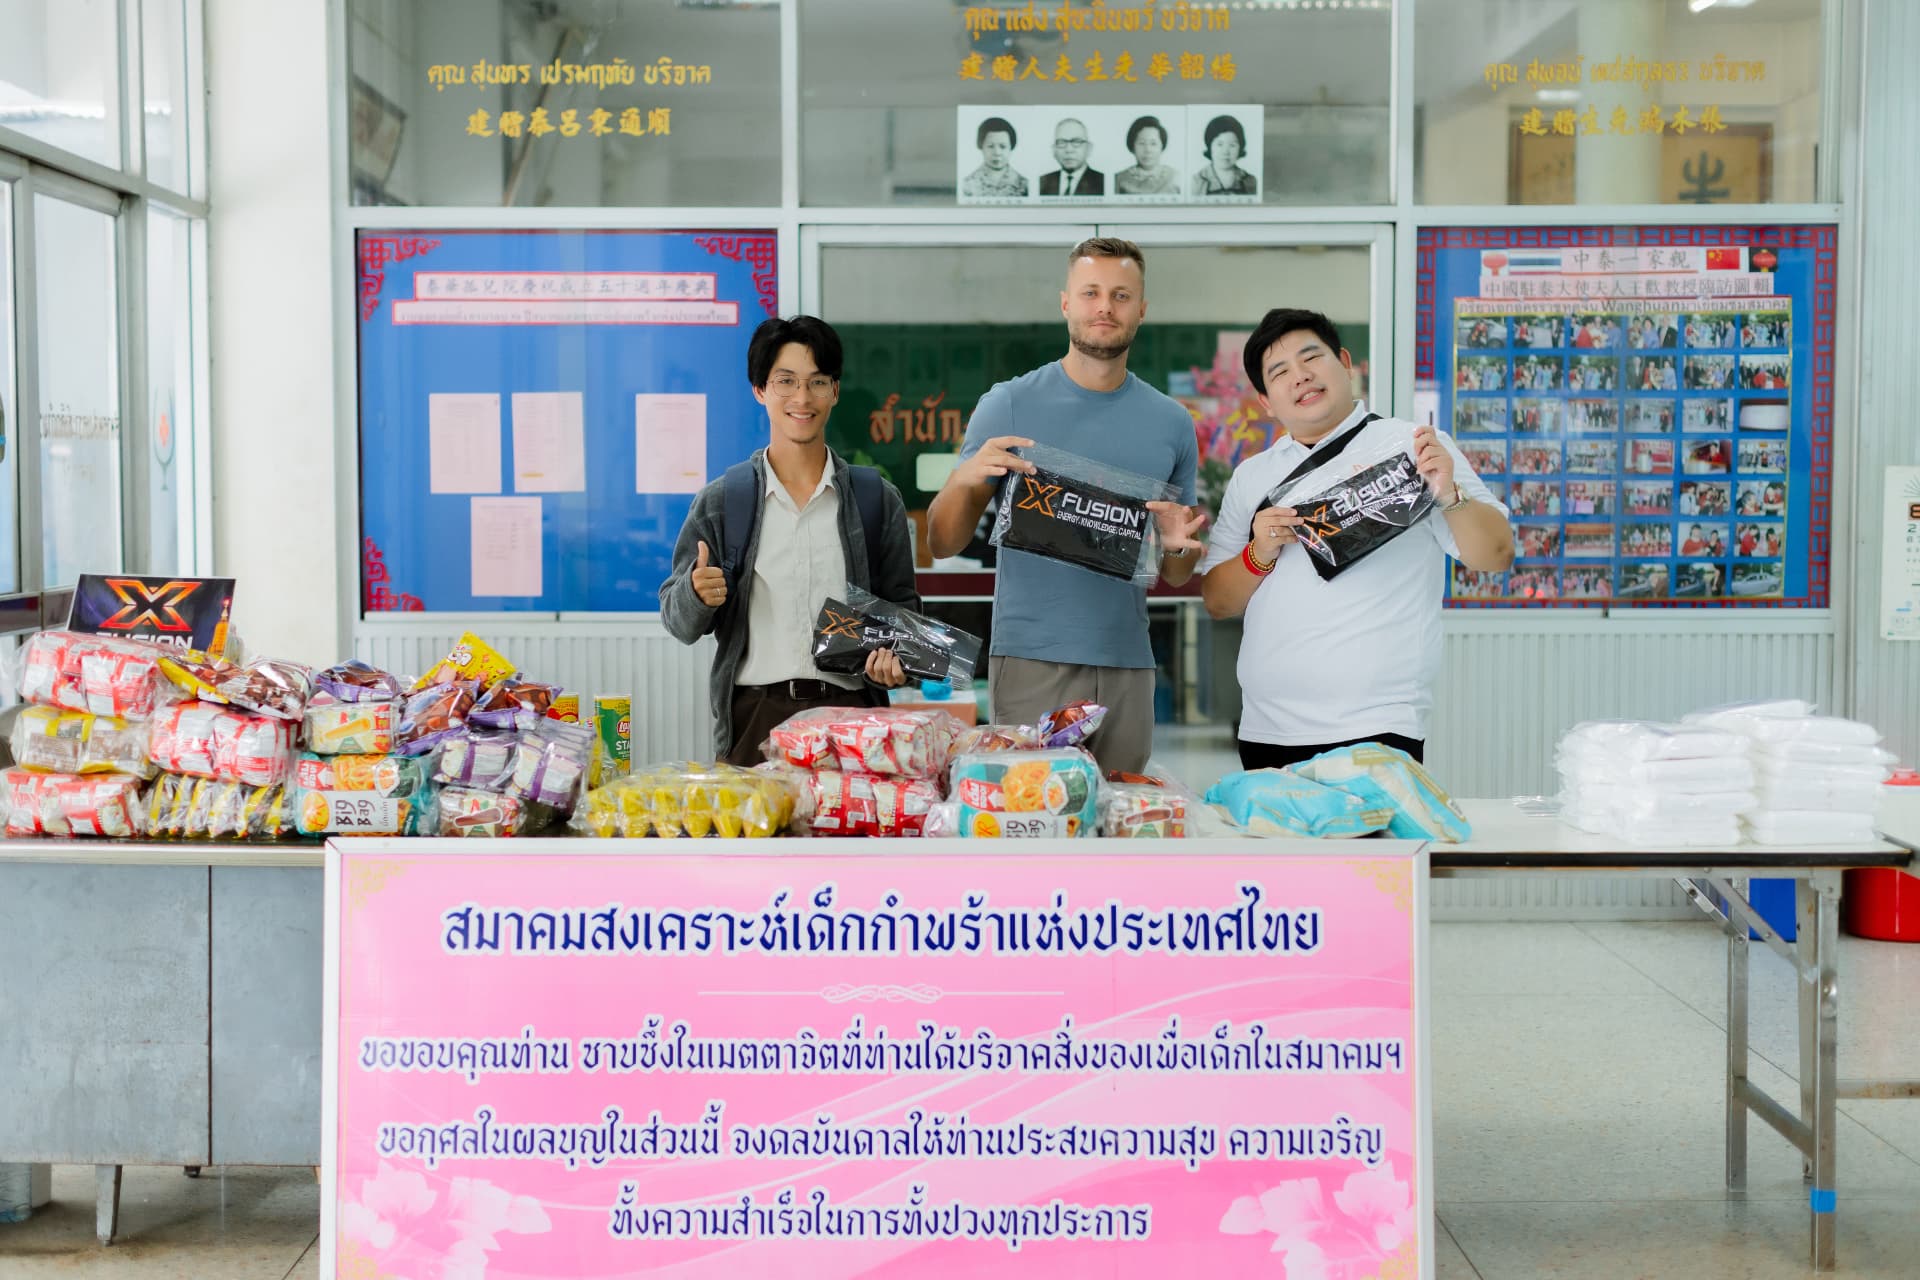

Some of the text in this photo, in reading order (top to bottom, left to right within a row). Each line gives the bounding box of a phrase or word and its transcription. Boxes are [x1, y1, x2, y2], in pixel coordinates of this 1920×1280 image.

[427, 64, 465, 92] คุณ
[643, 56, 712, 86] บริจาค
[870, 391, 966, 444] สำนัก
[445, 886, 1320, 951] สมาคมสงเคราะห์เด็กกำพร้าแห่งประเทศไทย
[361, 1030, 569, 1080] ขอขอบคุณท่าน
[379, 1104, 1383, 1166] ขอกุศลในผลบุญในส่วนนี้ จงดลบันดาลให้ท่านประสบความสุข ความเจริญ
[611, 1186, 1149, 1248] ทั้งความสำเร็จในการทั้งปวงทุกประการ
